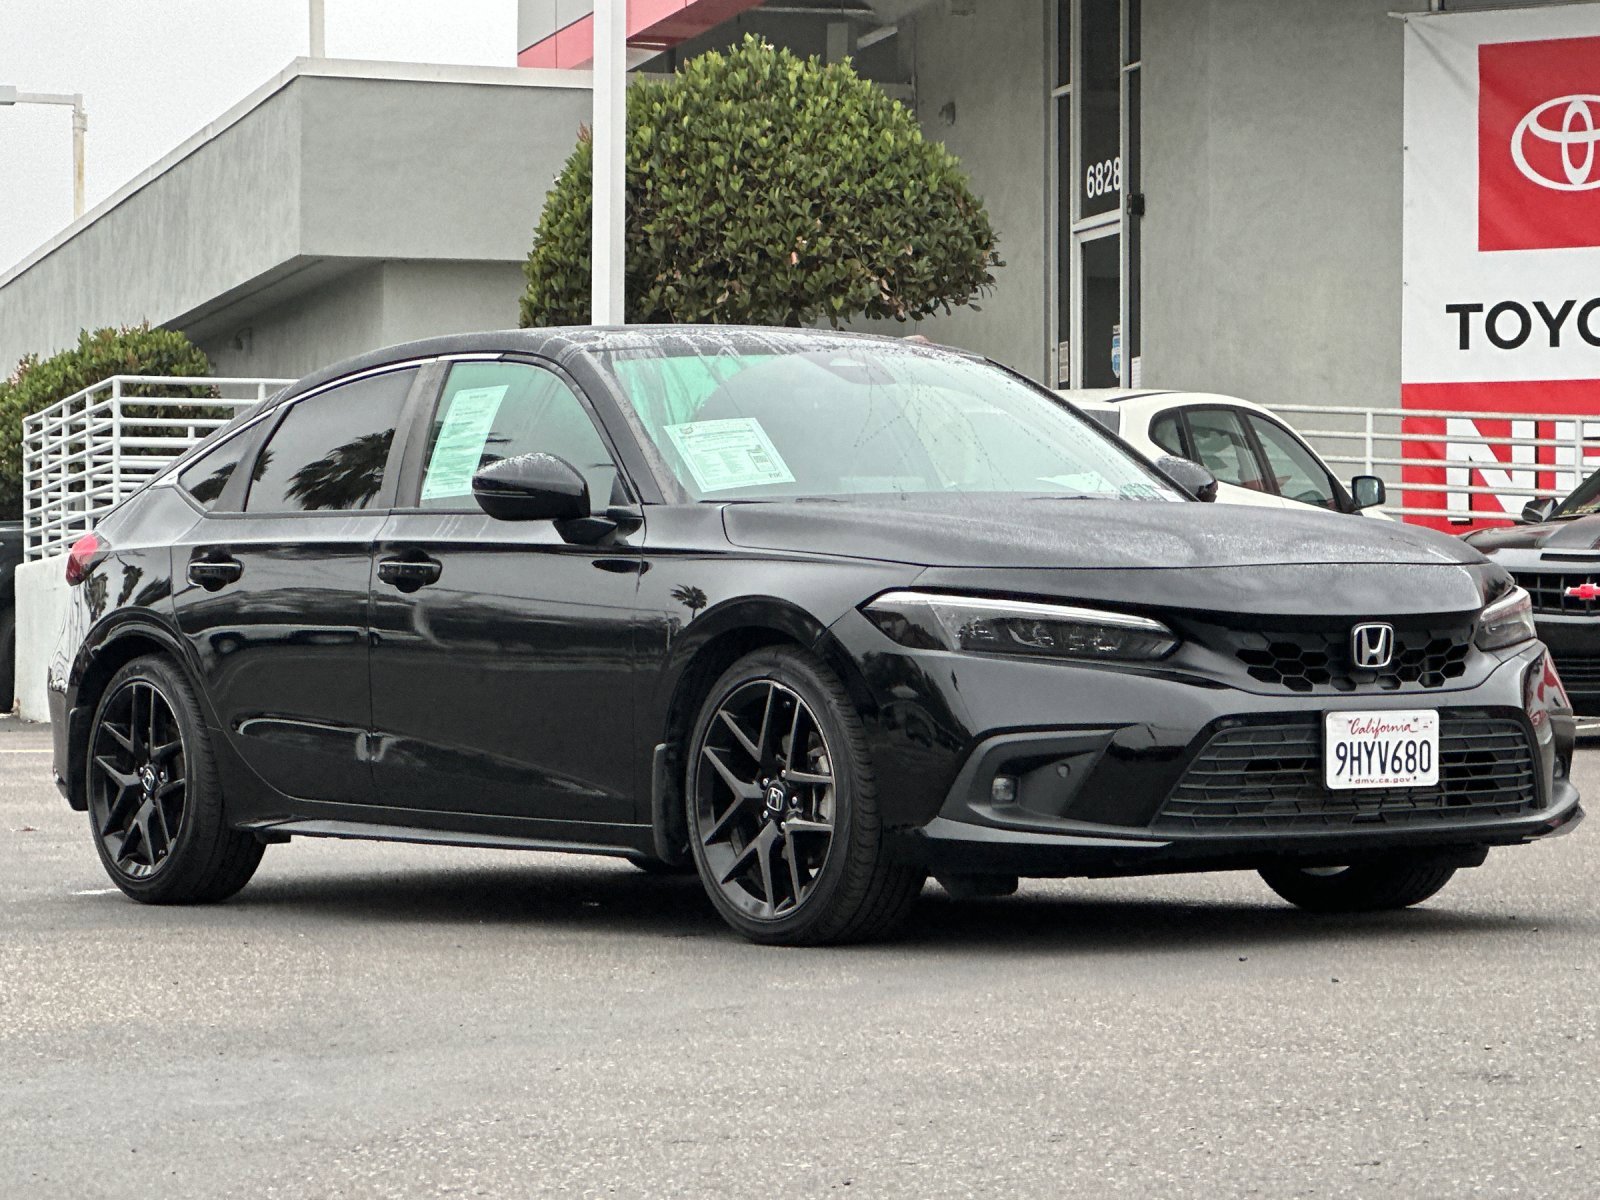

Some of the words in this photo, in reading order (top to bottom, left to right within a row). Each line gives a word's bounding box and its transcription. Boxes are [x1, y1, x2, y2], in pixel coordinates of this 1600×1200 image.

[1087, 157, 1120, 198] 6828
[1350, 718, 1417, 738] California
[1335, 739, 1431, 776] 9HYV680
[1355, 776, 1411, 784] dmv.ca.gov
